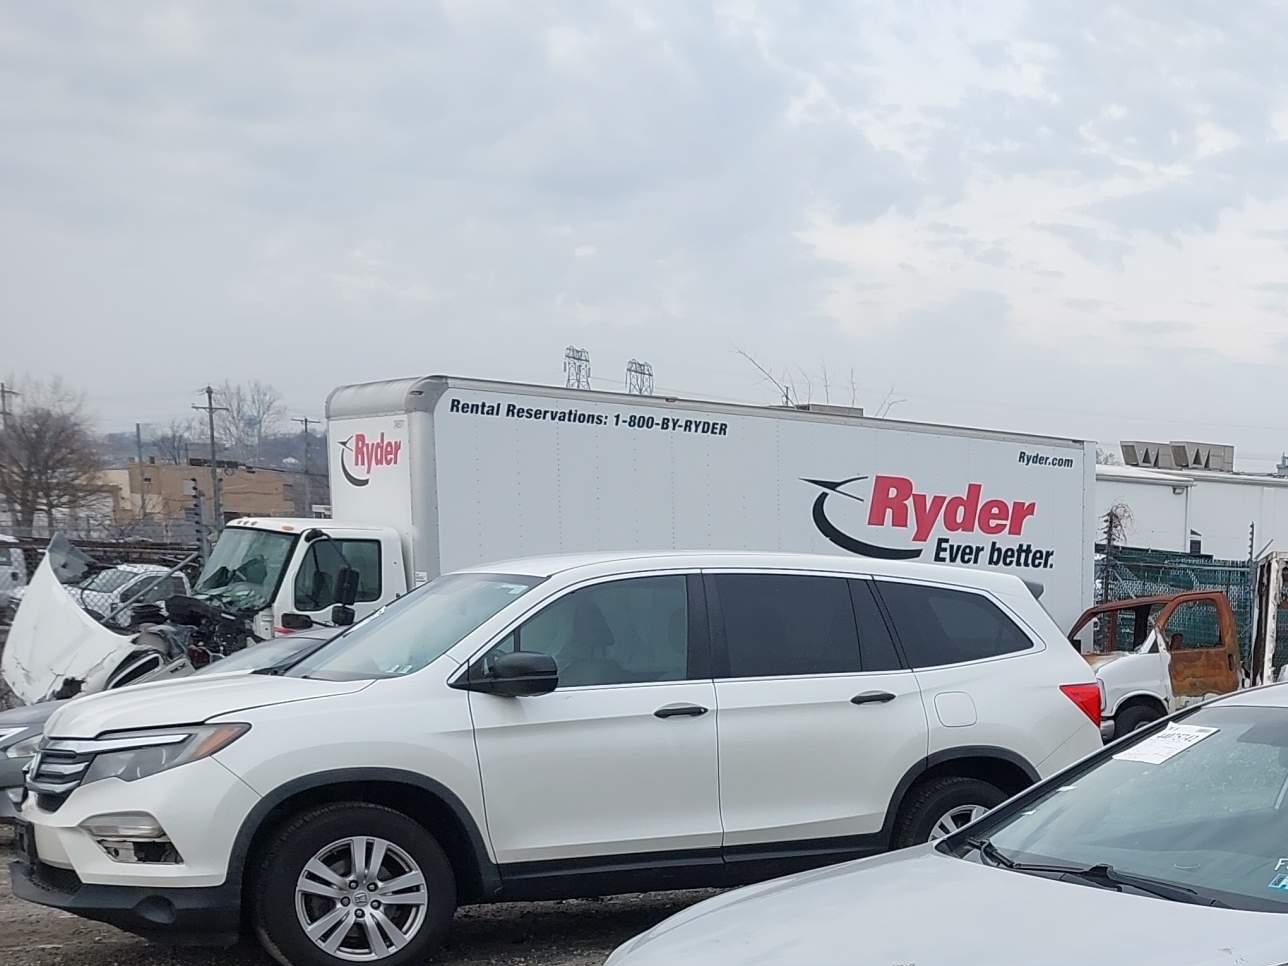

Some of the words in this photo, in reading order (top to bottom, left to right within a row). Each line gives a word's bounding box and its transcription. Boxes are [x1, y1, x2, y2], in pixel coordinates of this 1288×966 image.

[450, 399, 500, 417] Rental
[506, 404, 609, 427] Reservations:
[613, 413, 728, 436] 1-800-BY-RYDER
[355, 432, 401, 474] Ryder
[1018, 451, 1073, 468] Ryder.com
[868, 475, 1036, 542] Ryder
[934, 537, 985, 565] Ever
[988, 541, 1055, 570] better.
